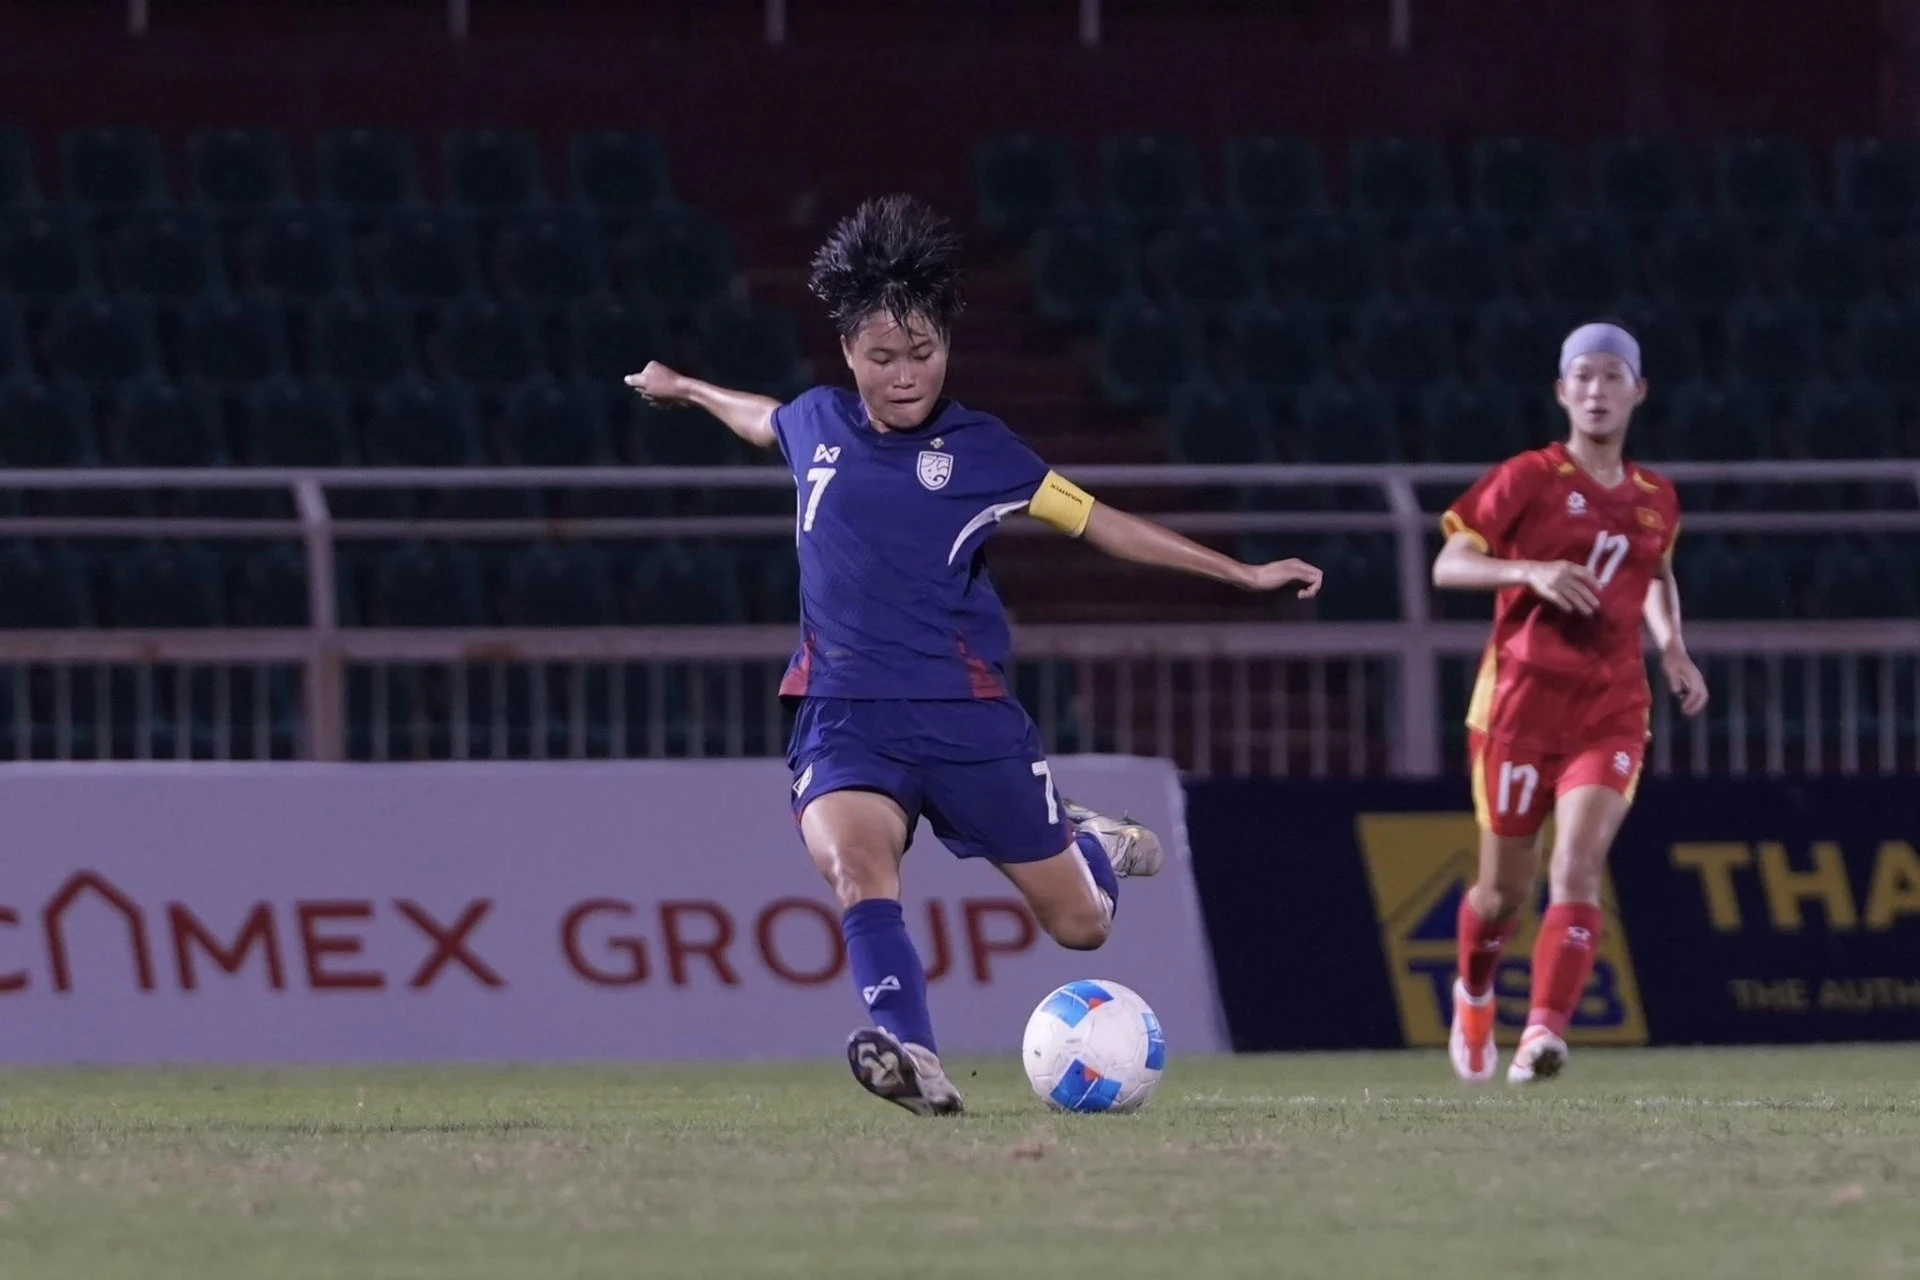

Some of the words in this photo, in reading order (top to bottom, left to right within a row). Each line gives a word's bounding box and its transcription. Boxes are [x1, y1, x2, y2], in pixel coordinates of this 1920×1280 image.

[804, 467, 837, 532] 7
[1587, 530, 1630, 588] 17
[1032, 760, 1060, 825] 7
[1497, 762, 1538, 814] 17
[1731, 978, 1809, 1010] THE
